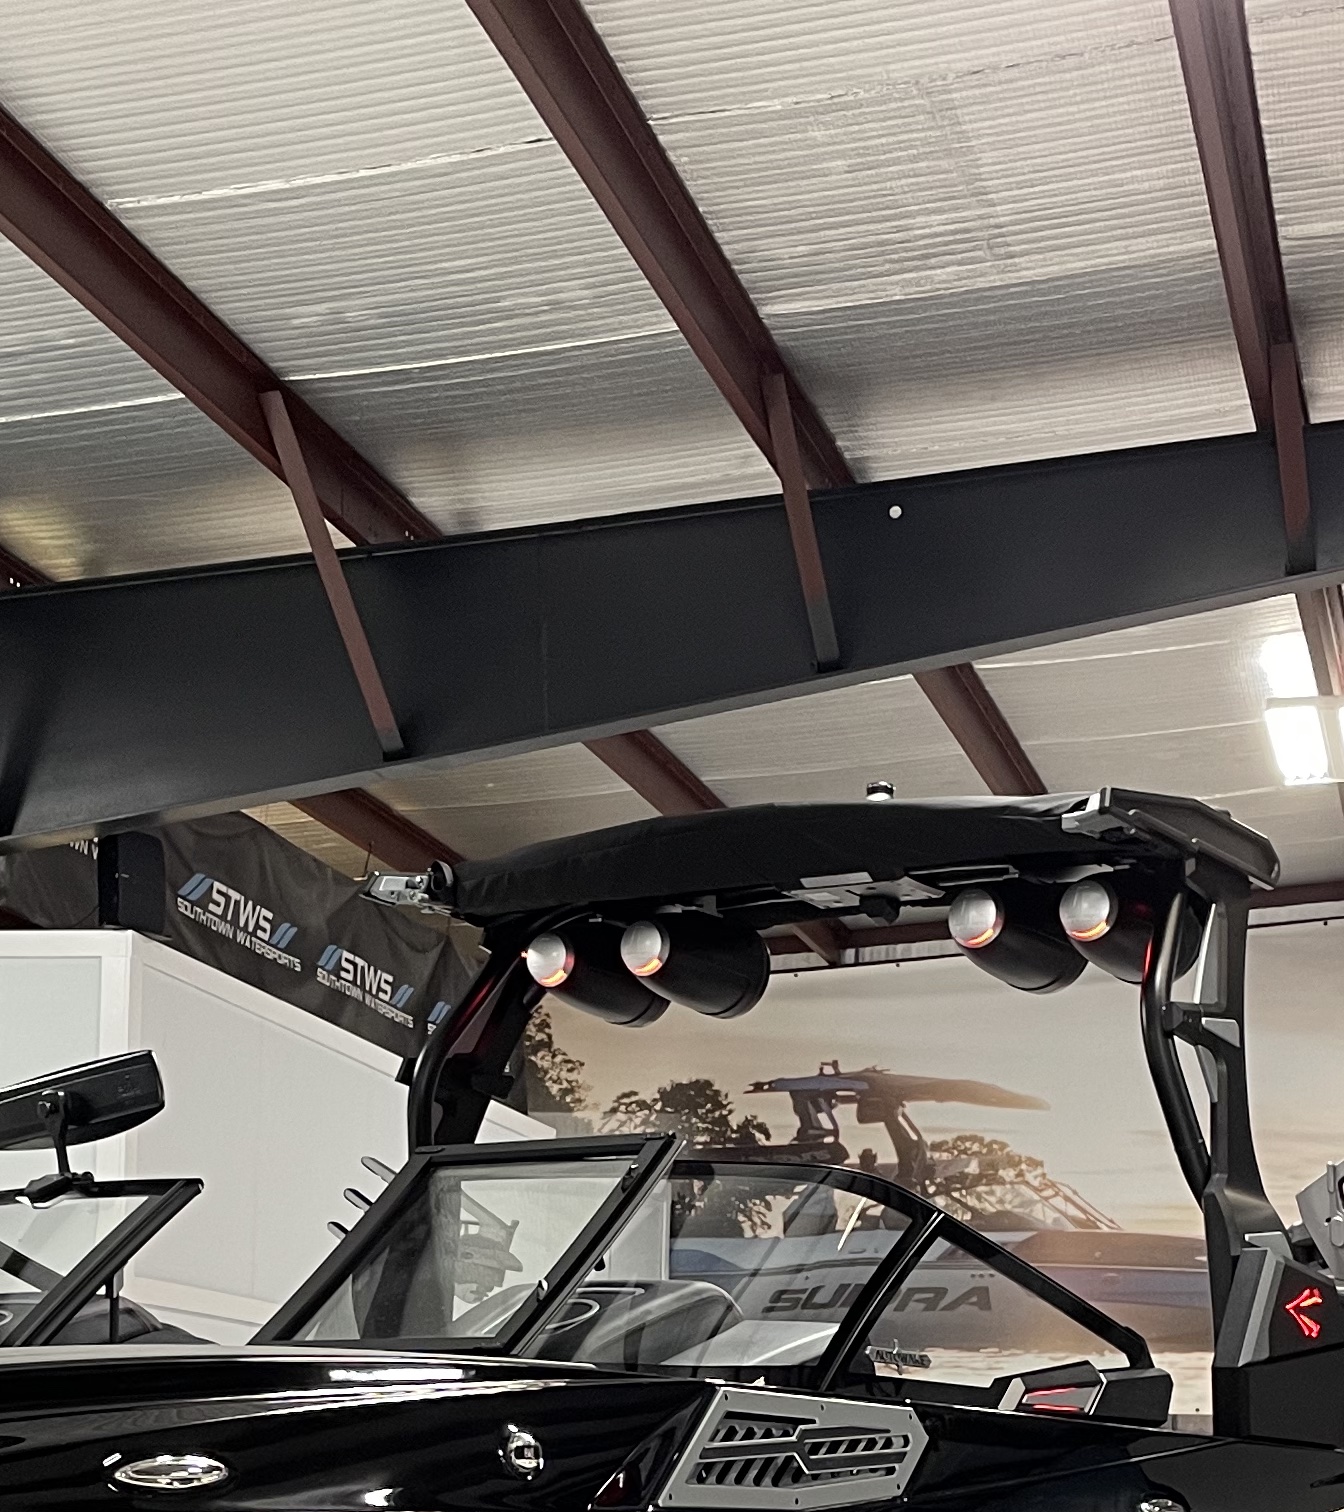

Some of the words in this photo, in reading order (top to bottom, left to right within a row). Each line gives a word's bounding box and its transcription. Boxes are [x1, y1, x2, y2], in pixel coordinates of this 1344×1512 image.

[177, 896, 235, 939] SOUTHTOWN
[236, 926, 302, 972] WATERSPORTS
[208, 880, 274, 942] STWS
[339, 949, 394, 1003] STWS
